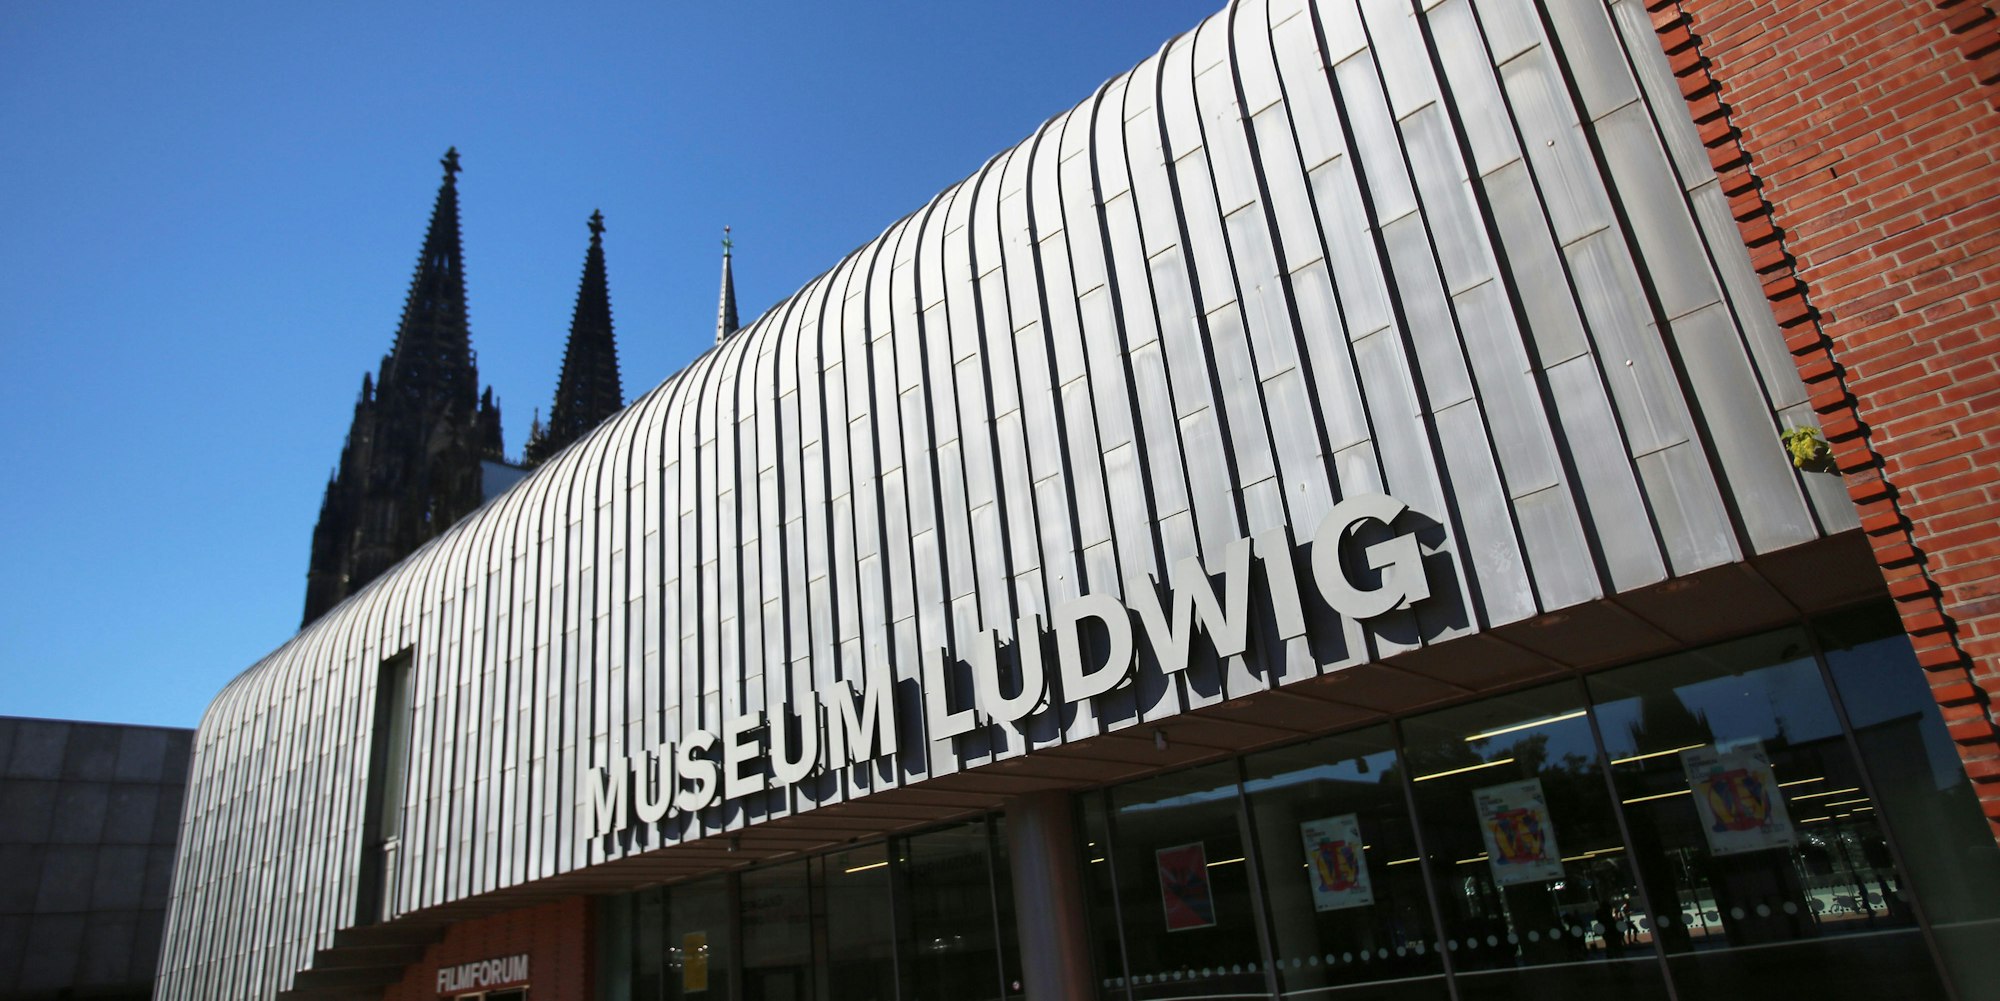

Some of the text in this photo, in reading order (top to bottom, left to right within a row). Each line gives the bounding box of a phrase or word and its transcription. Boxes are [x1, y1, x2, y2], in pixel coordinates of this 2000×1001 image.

[584, 495, 1430, 839] MUSEUM LUDWIG
[437, 954, 529, 993] FILMFORUM
